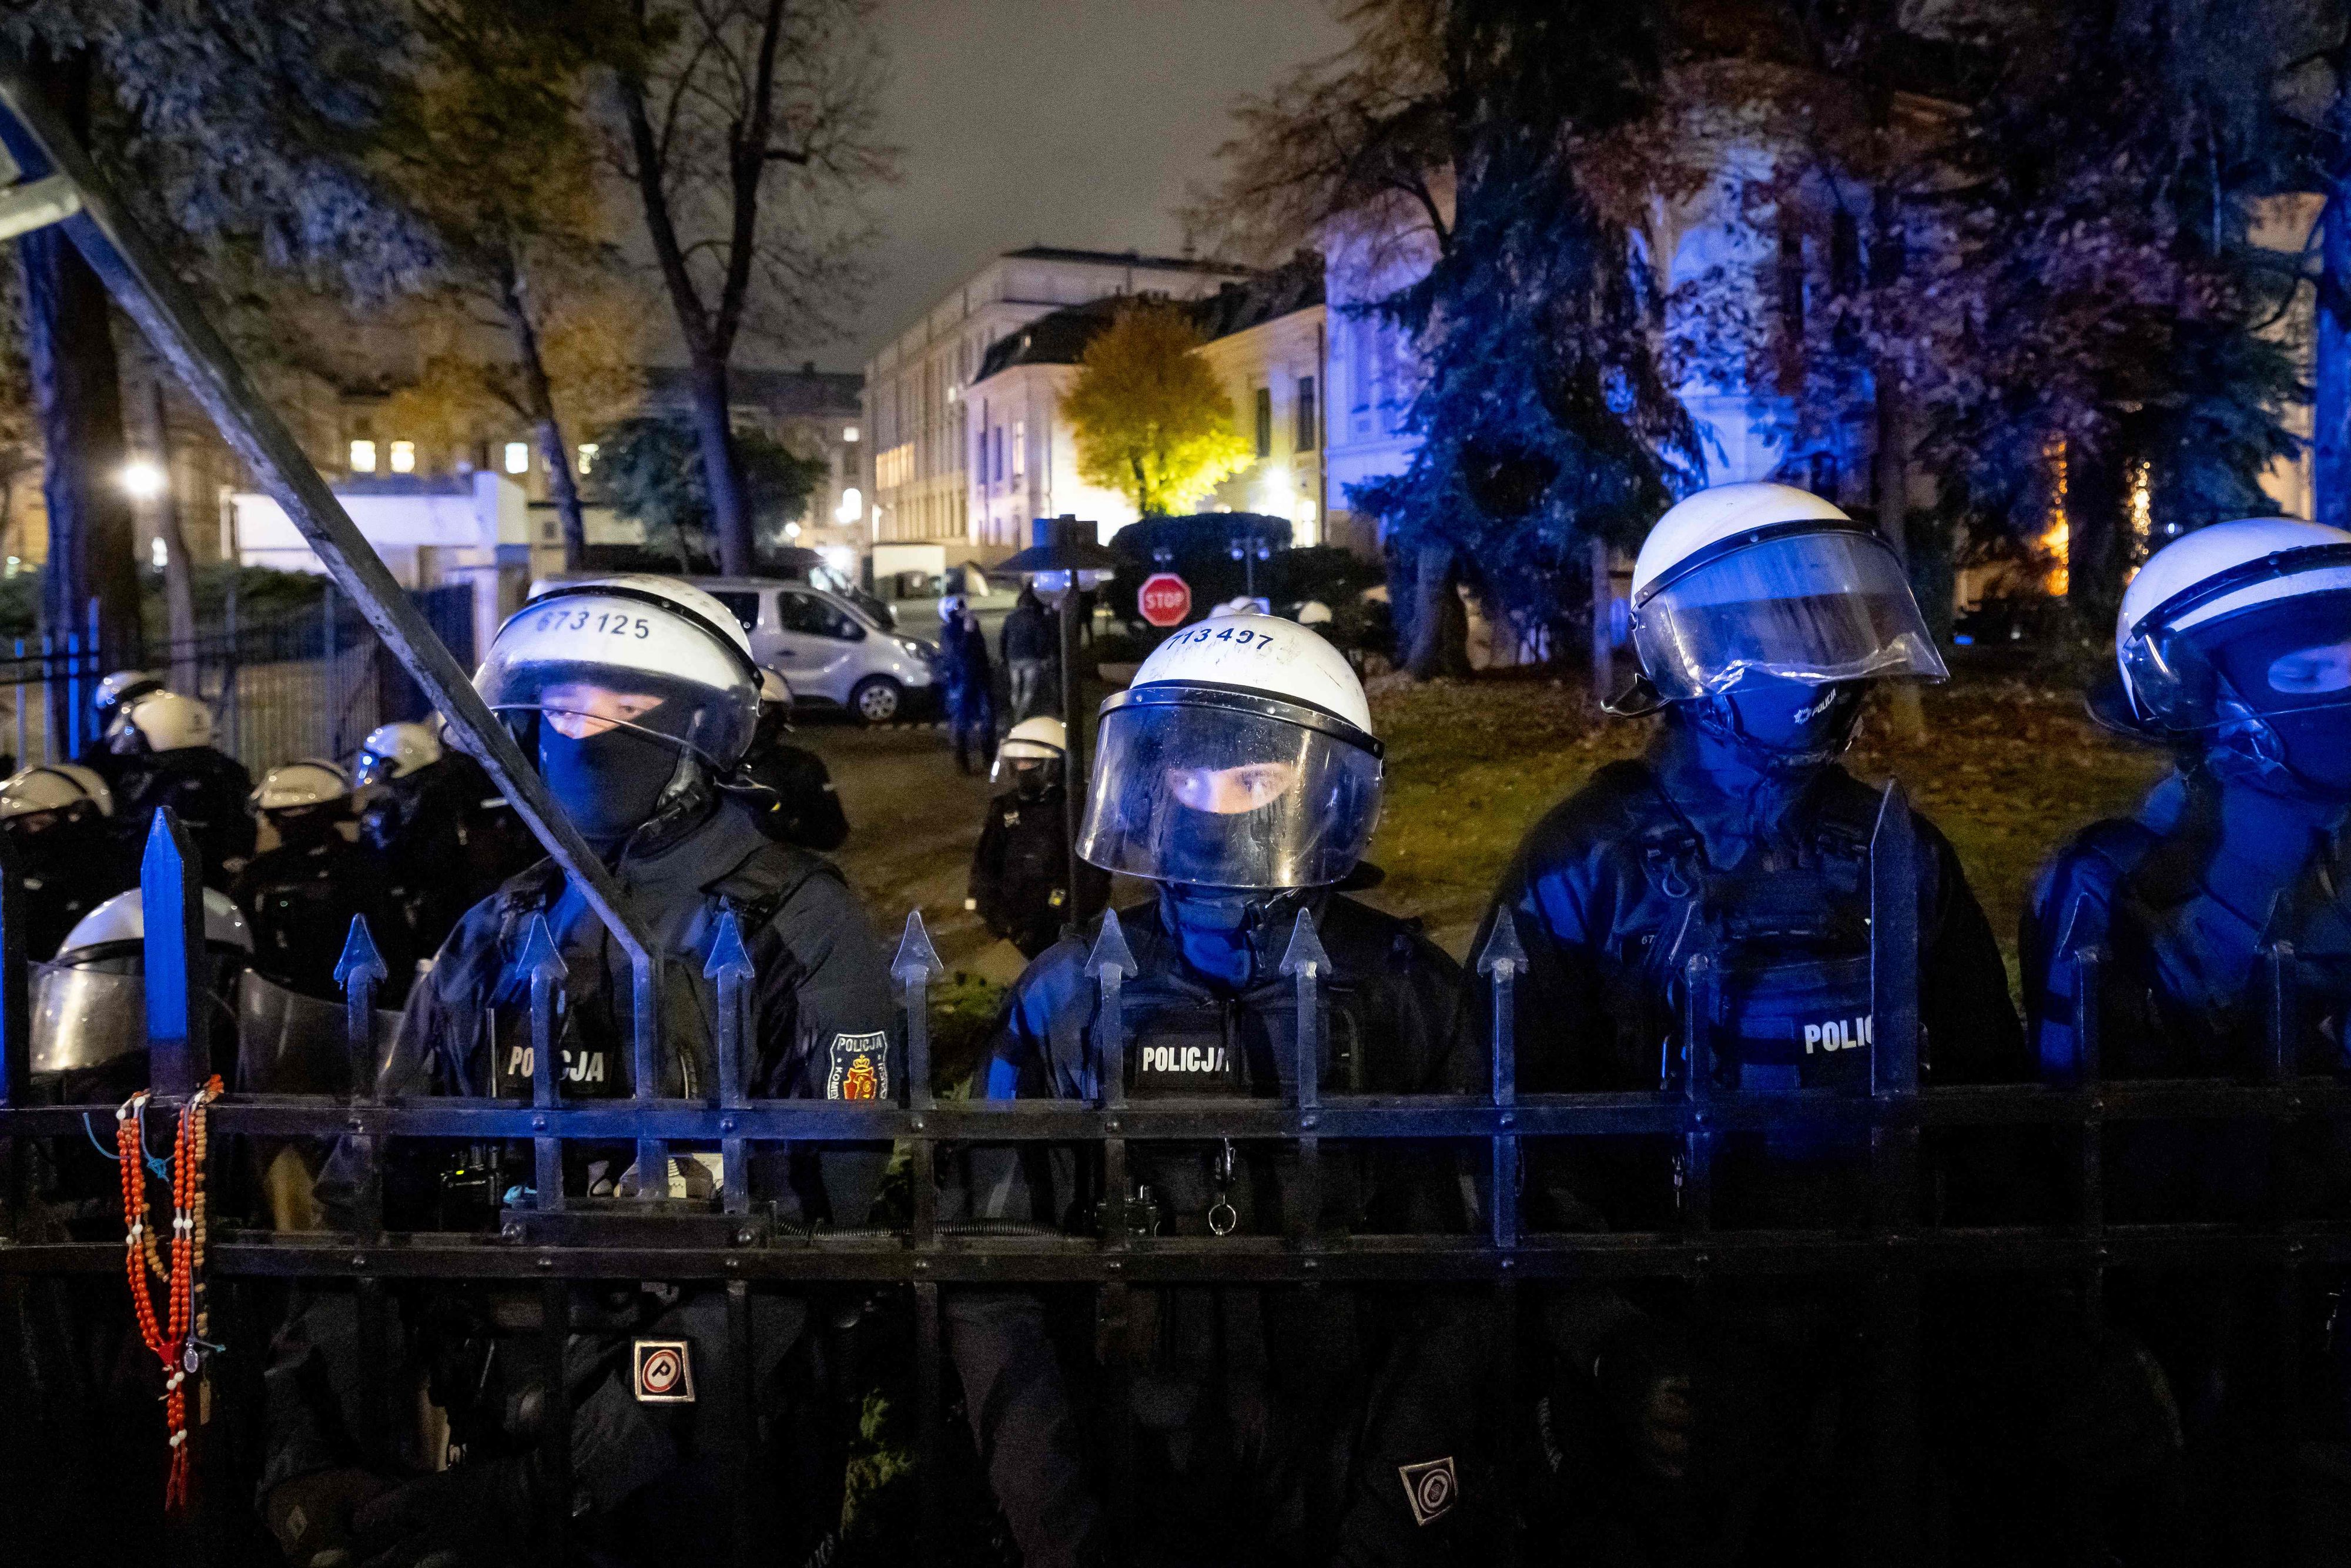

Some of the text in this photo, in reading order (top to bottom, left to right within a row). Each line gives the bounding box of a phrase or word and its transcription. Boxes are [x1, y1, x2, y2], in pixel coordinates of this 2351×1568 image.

[1146, 591, 1184, 609] STOP
[598, 612, 649, 639] 125
[1166, 628, 1274, 651] 713 497
[1811, 688, 1836, 717] POLICJA
[837, 1036, 883, 1052] POLICJA
[508, 1046, 604, 1082] POCJA
[652, 1360, 671, 1377] P
